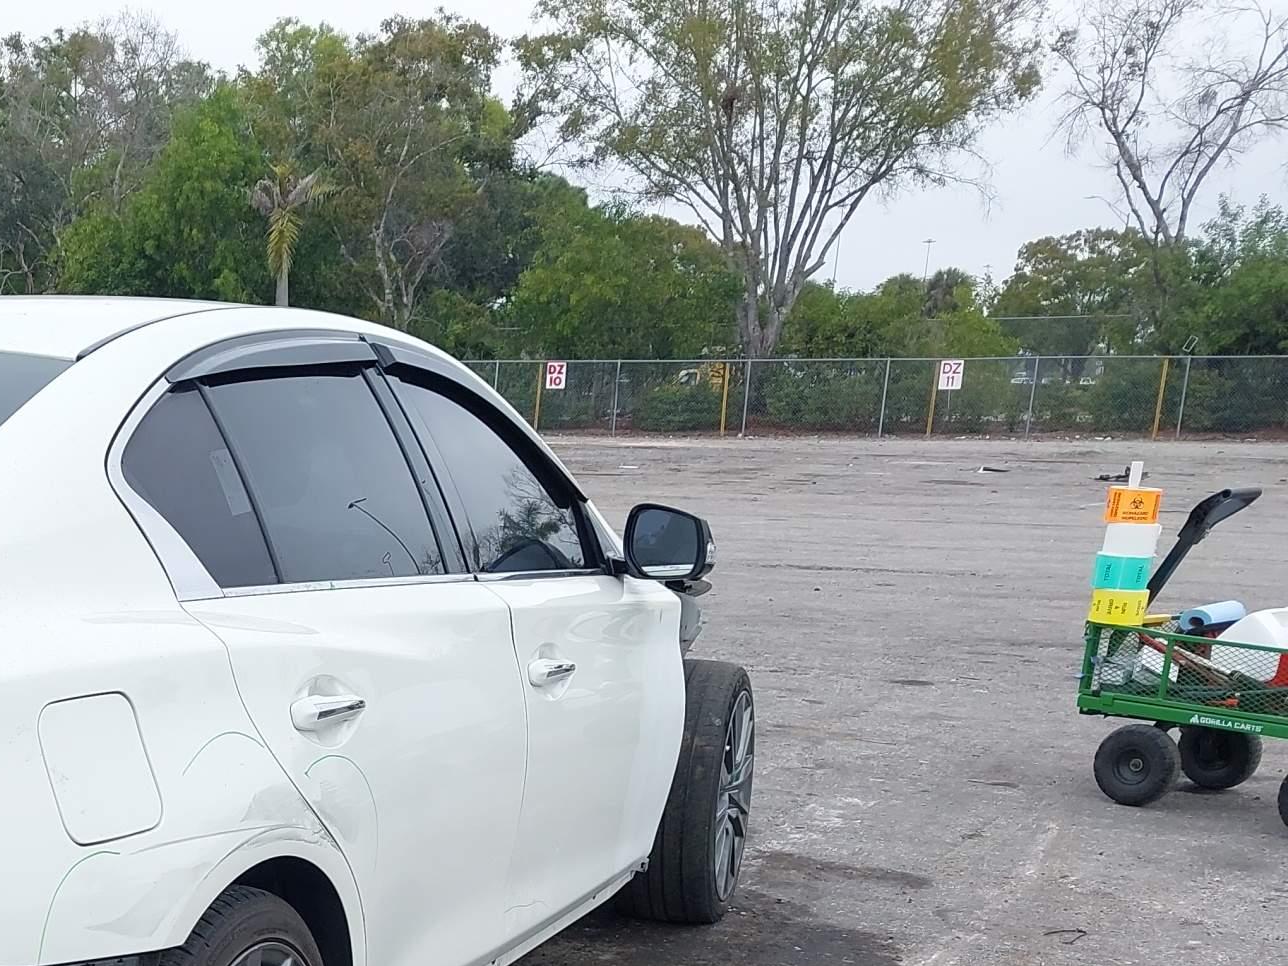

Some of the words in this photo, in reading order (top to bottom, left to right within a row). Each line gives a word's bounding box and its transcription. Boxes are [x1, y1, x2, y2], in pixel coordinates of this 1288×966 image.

[548, 364, 565, 375] DZ
[943, 362, 962, 375] DZ
[549, 376, 562, 387] 10
[946, 376, 955, 387] 11
[1103, 563, 1112, 582] TOTAL
[1200, 717, 1233, 728] GORILLA
[1233, 722, 1262, 733] CARTS
